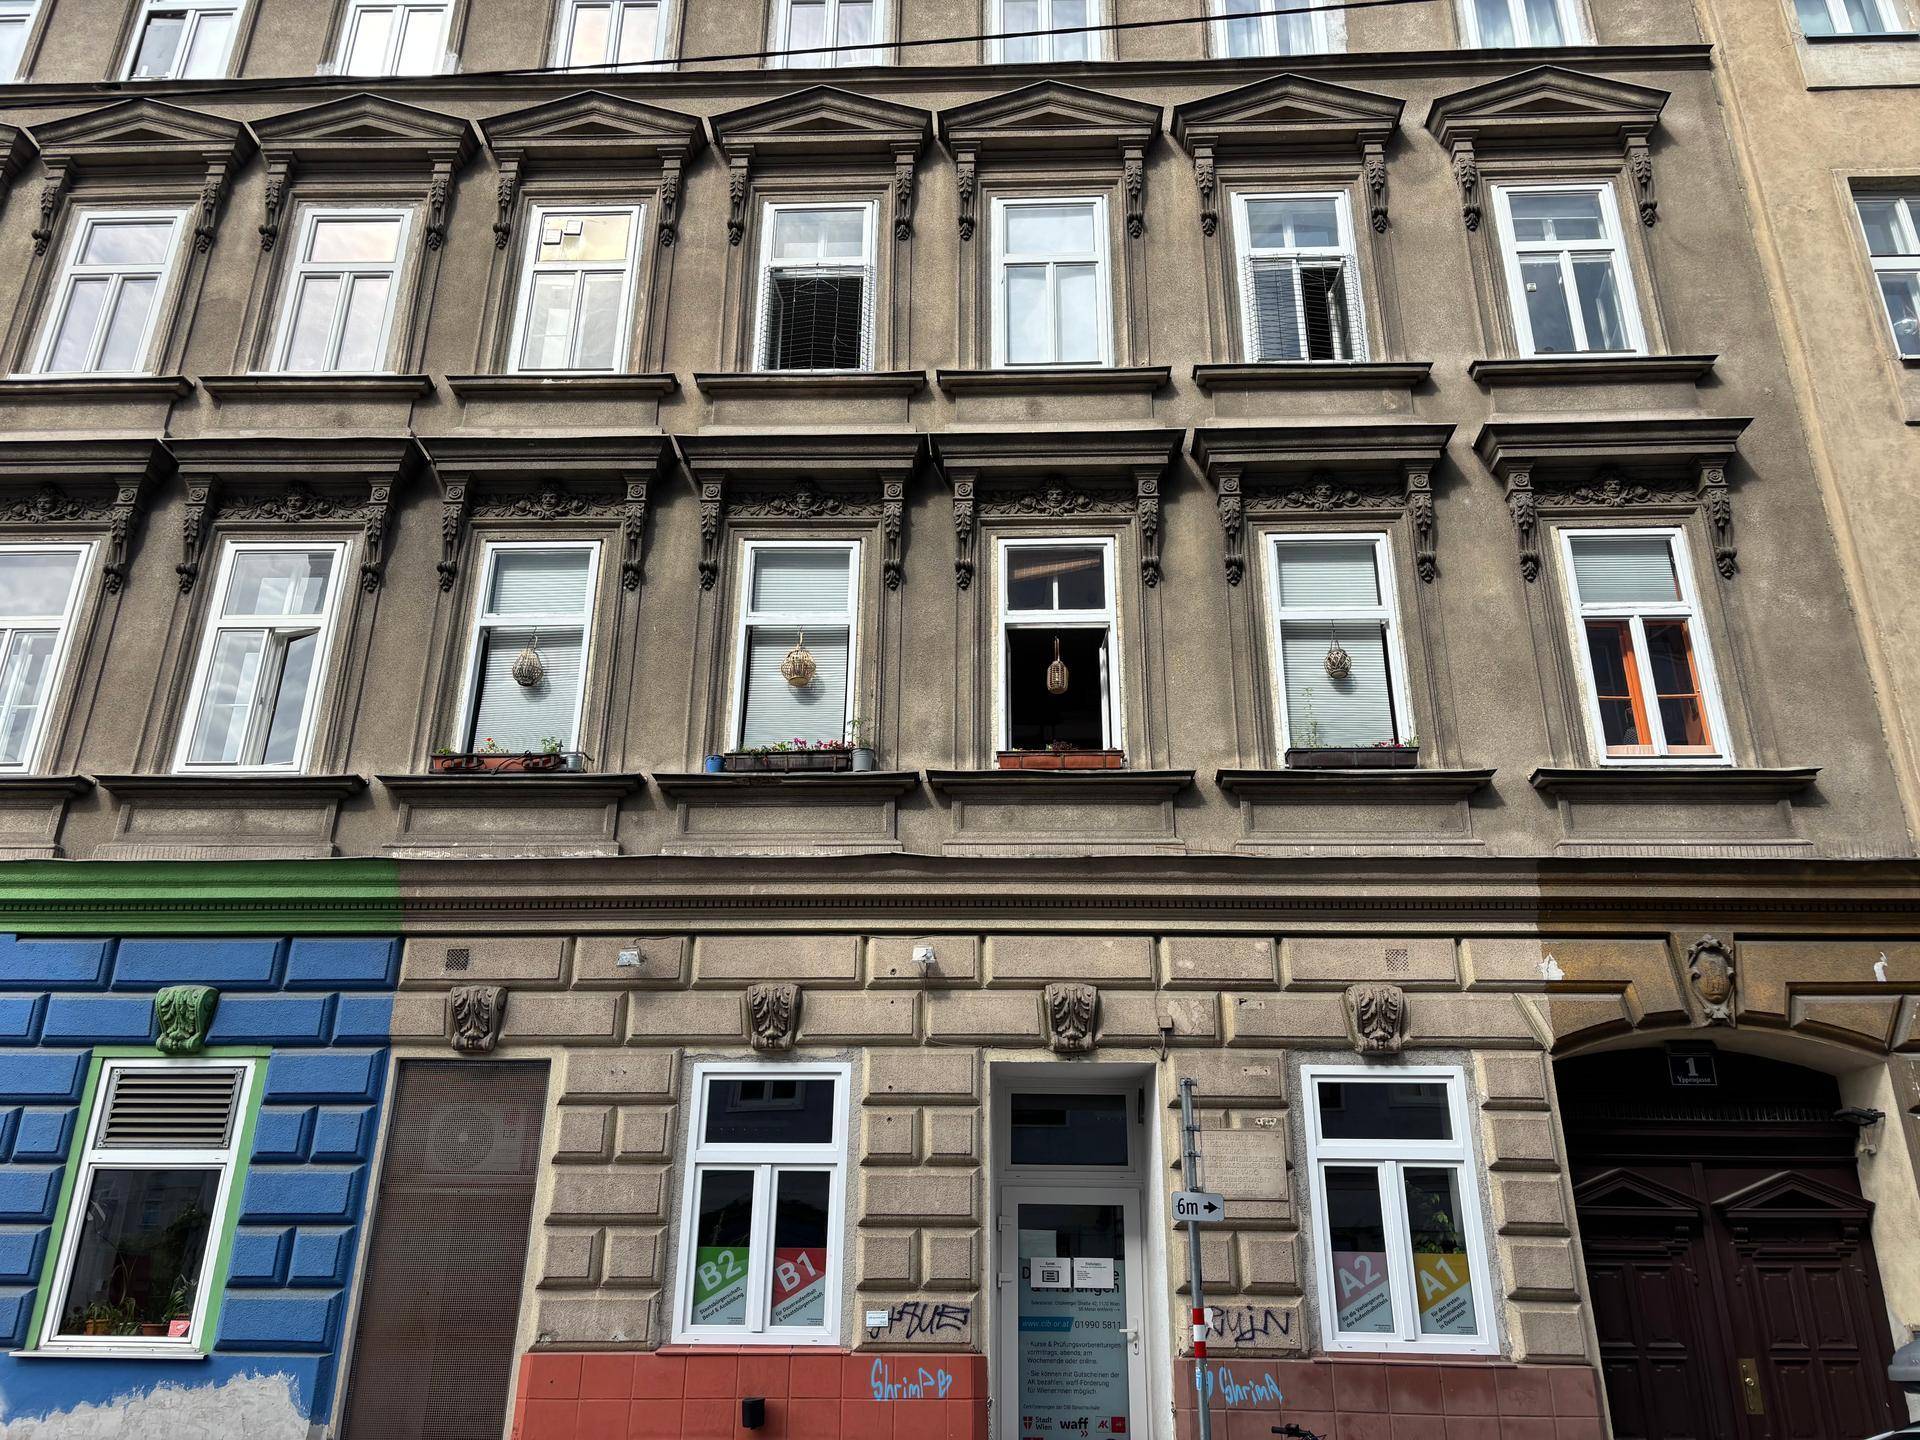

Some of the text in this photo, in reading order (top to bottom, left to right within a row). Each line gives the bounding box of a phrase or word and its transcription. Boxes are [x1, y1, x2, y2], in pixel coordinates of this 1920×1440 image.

[1685, 1057, 1698, 1076] 1
[1177, 1197, 1199, 1216] 6m
[698, 1250, 742, 1291] B2
[776, 1250, 817, 1292] B1
[1338, 1255, 1381, 1299] A2
[1419, 1257, 1459, 1301] A1
[1035, 1423, 1053, 1431] Wien
[1059, 1417, 1089, 1430] waff
